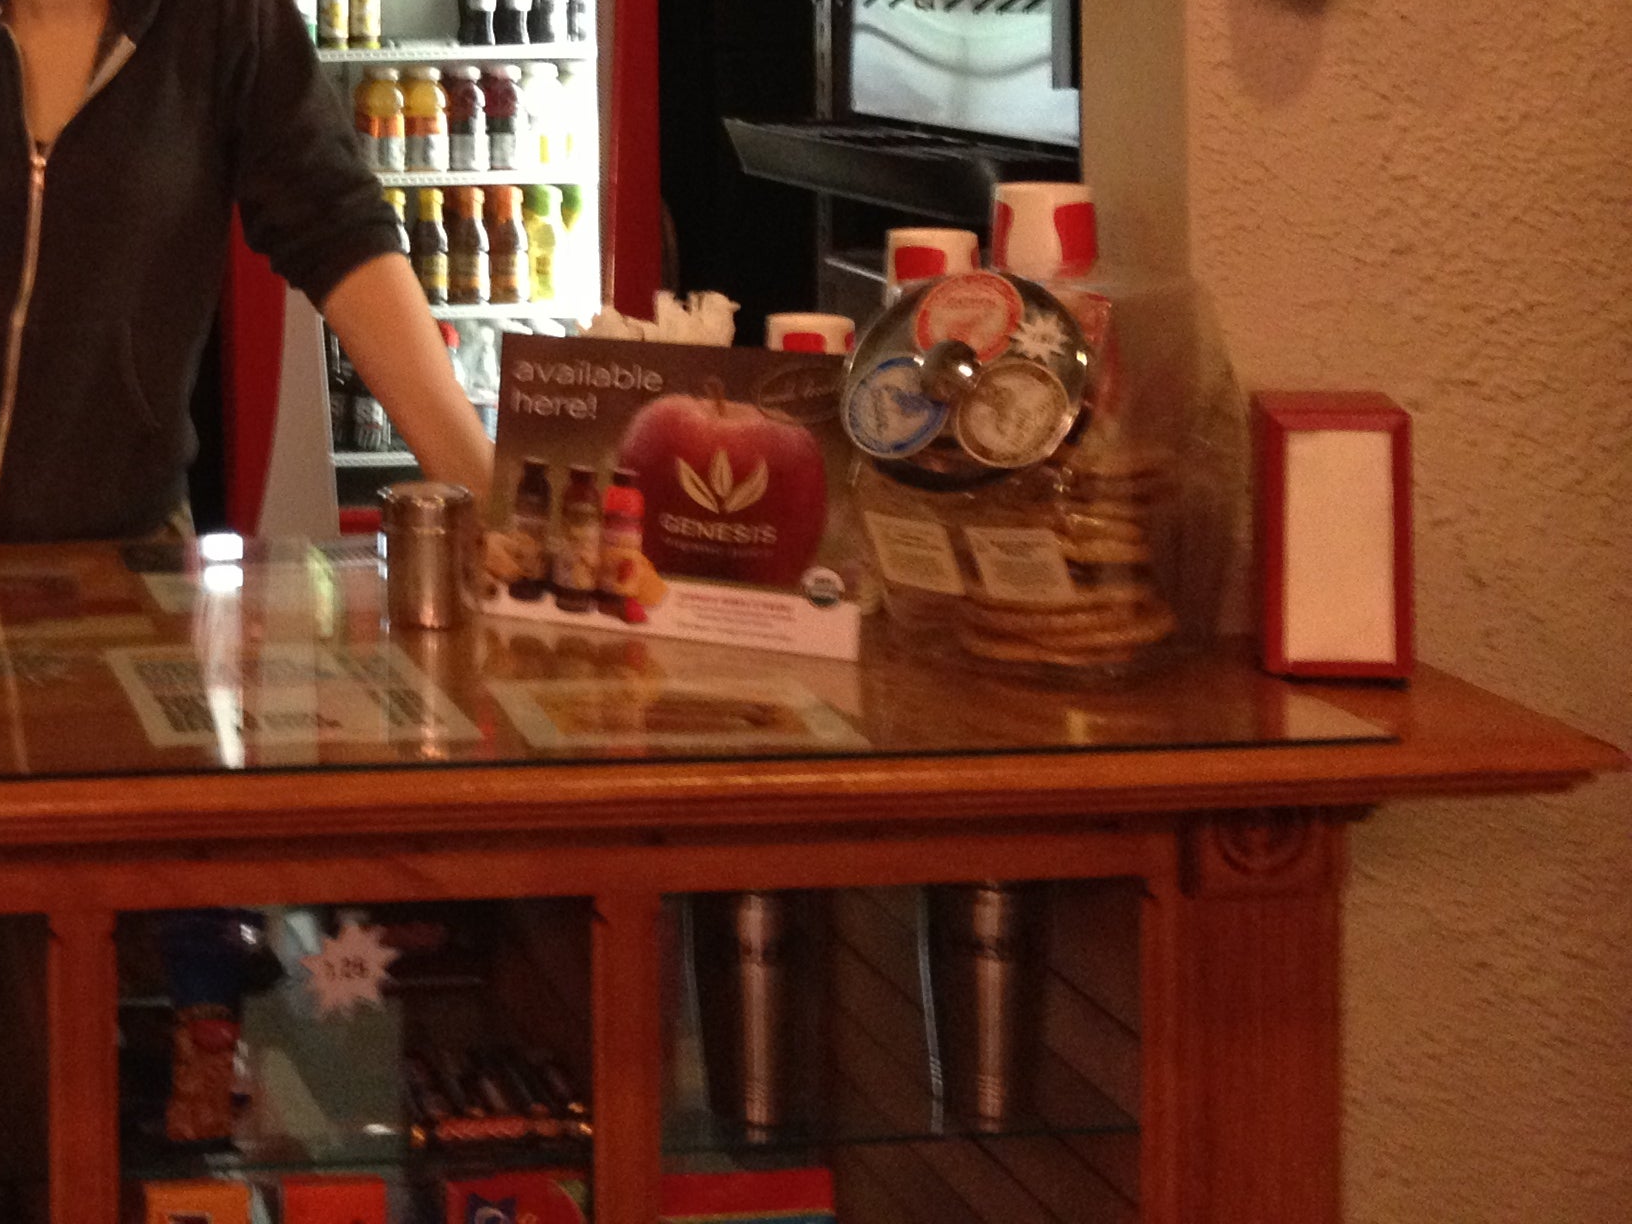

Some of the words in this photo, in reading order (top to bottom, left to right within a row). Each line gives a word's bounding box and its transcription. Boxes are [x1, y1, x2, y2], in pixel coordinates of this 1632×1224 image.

[513, 359, 665, 393] available
[510, 390, 599, 421] here!
[659, 512, 778, 544] GENESIS
